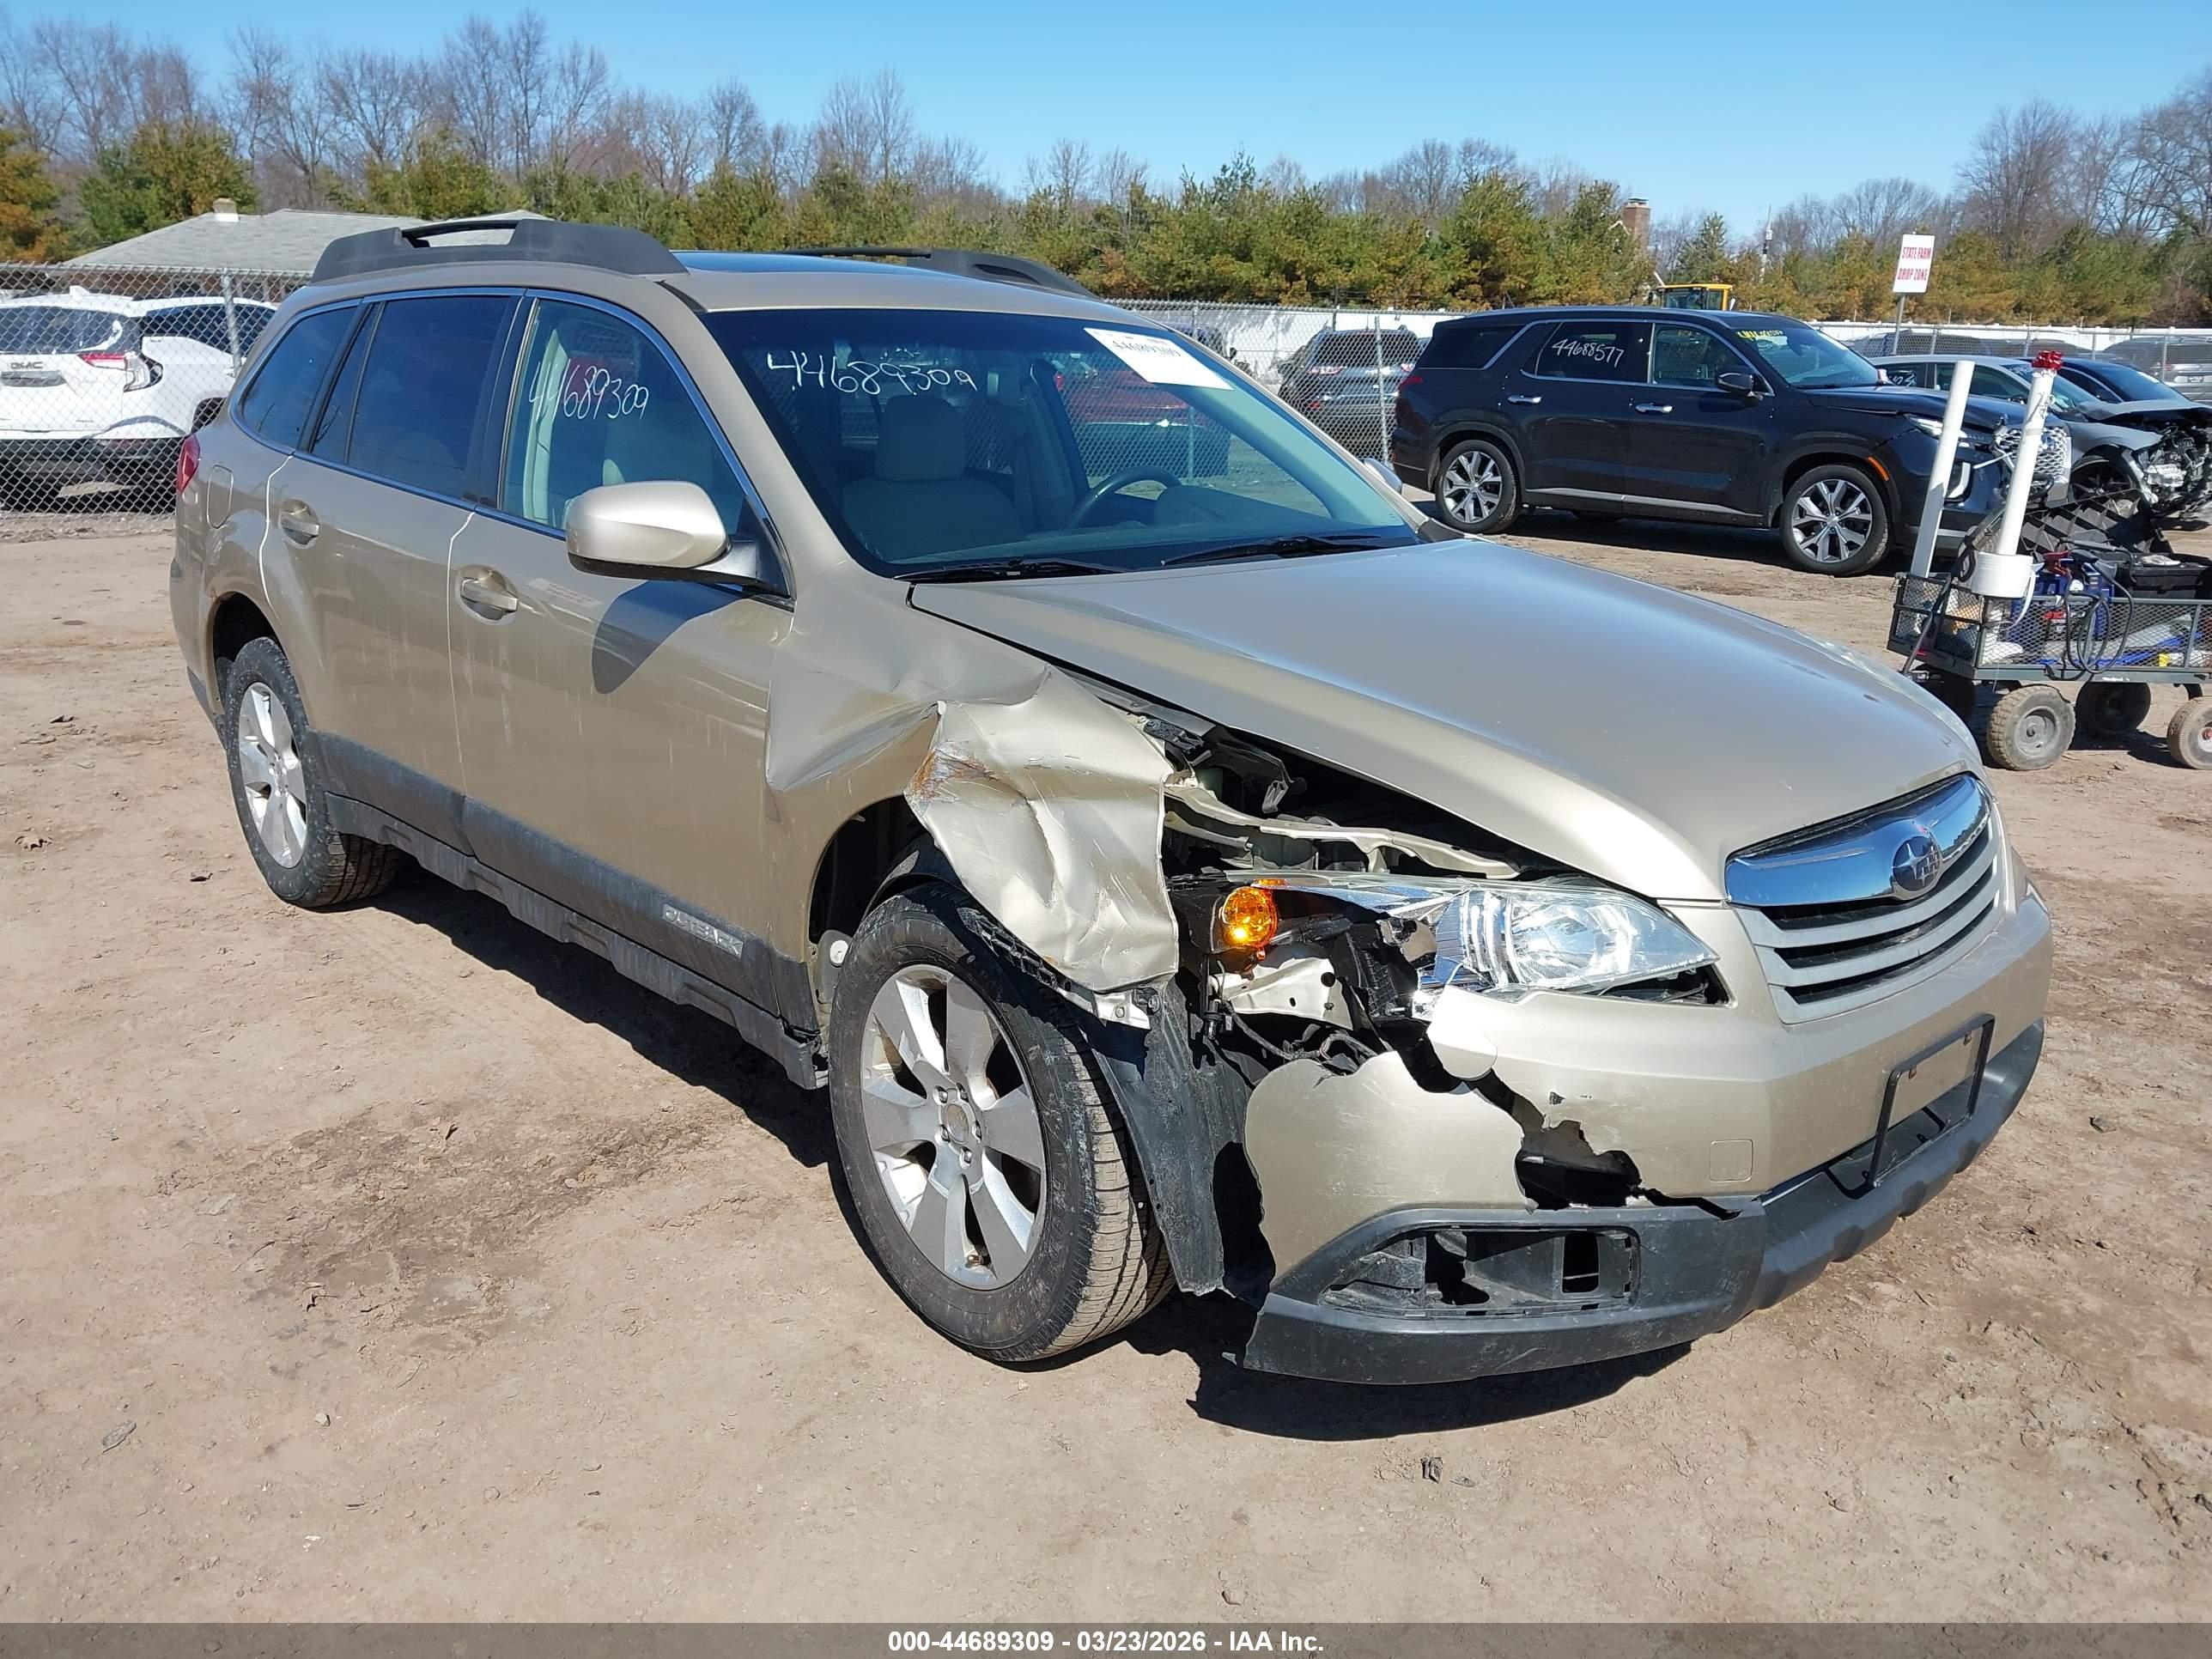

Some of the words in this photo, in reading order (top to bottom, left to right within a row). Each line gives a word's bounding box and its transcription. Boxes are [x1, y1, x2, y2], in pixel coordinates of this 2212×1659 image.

[1902, 246, 1917, 259] STATE
[1917, 246, 1932, 259] FARM
[1898, 268, 1914, 281] DROP
[1913, 268, 1929, 281] ZONE
[1552, 338, 1625, 368] 44688577
[528, 358, 650, 424] 44689309
[767, 349, 978, 396] 44689309
[665, 908, 742, 957] OUTBACK
